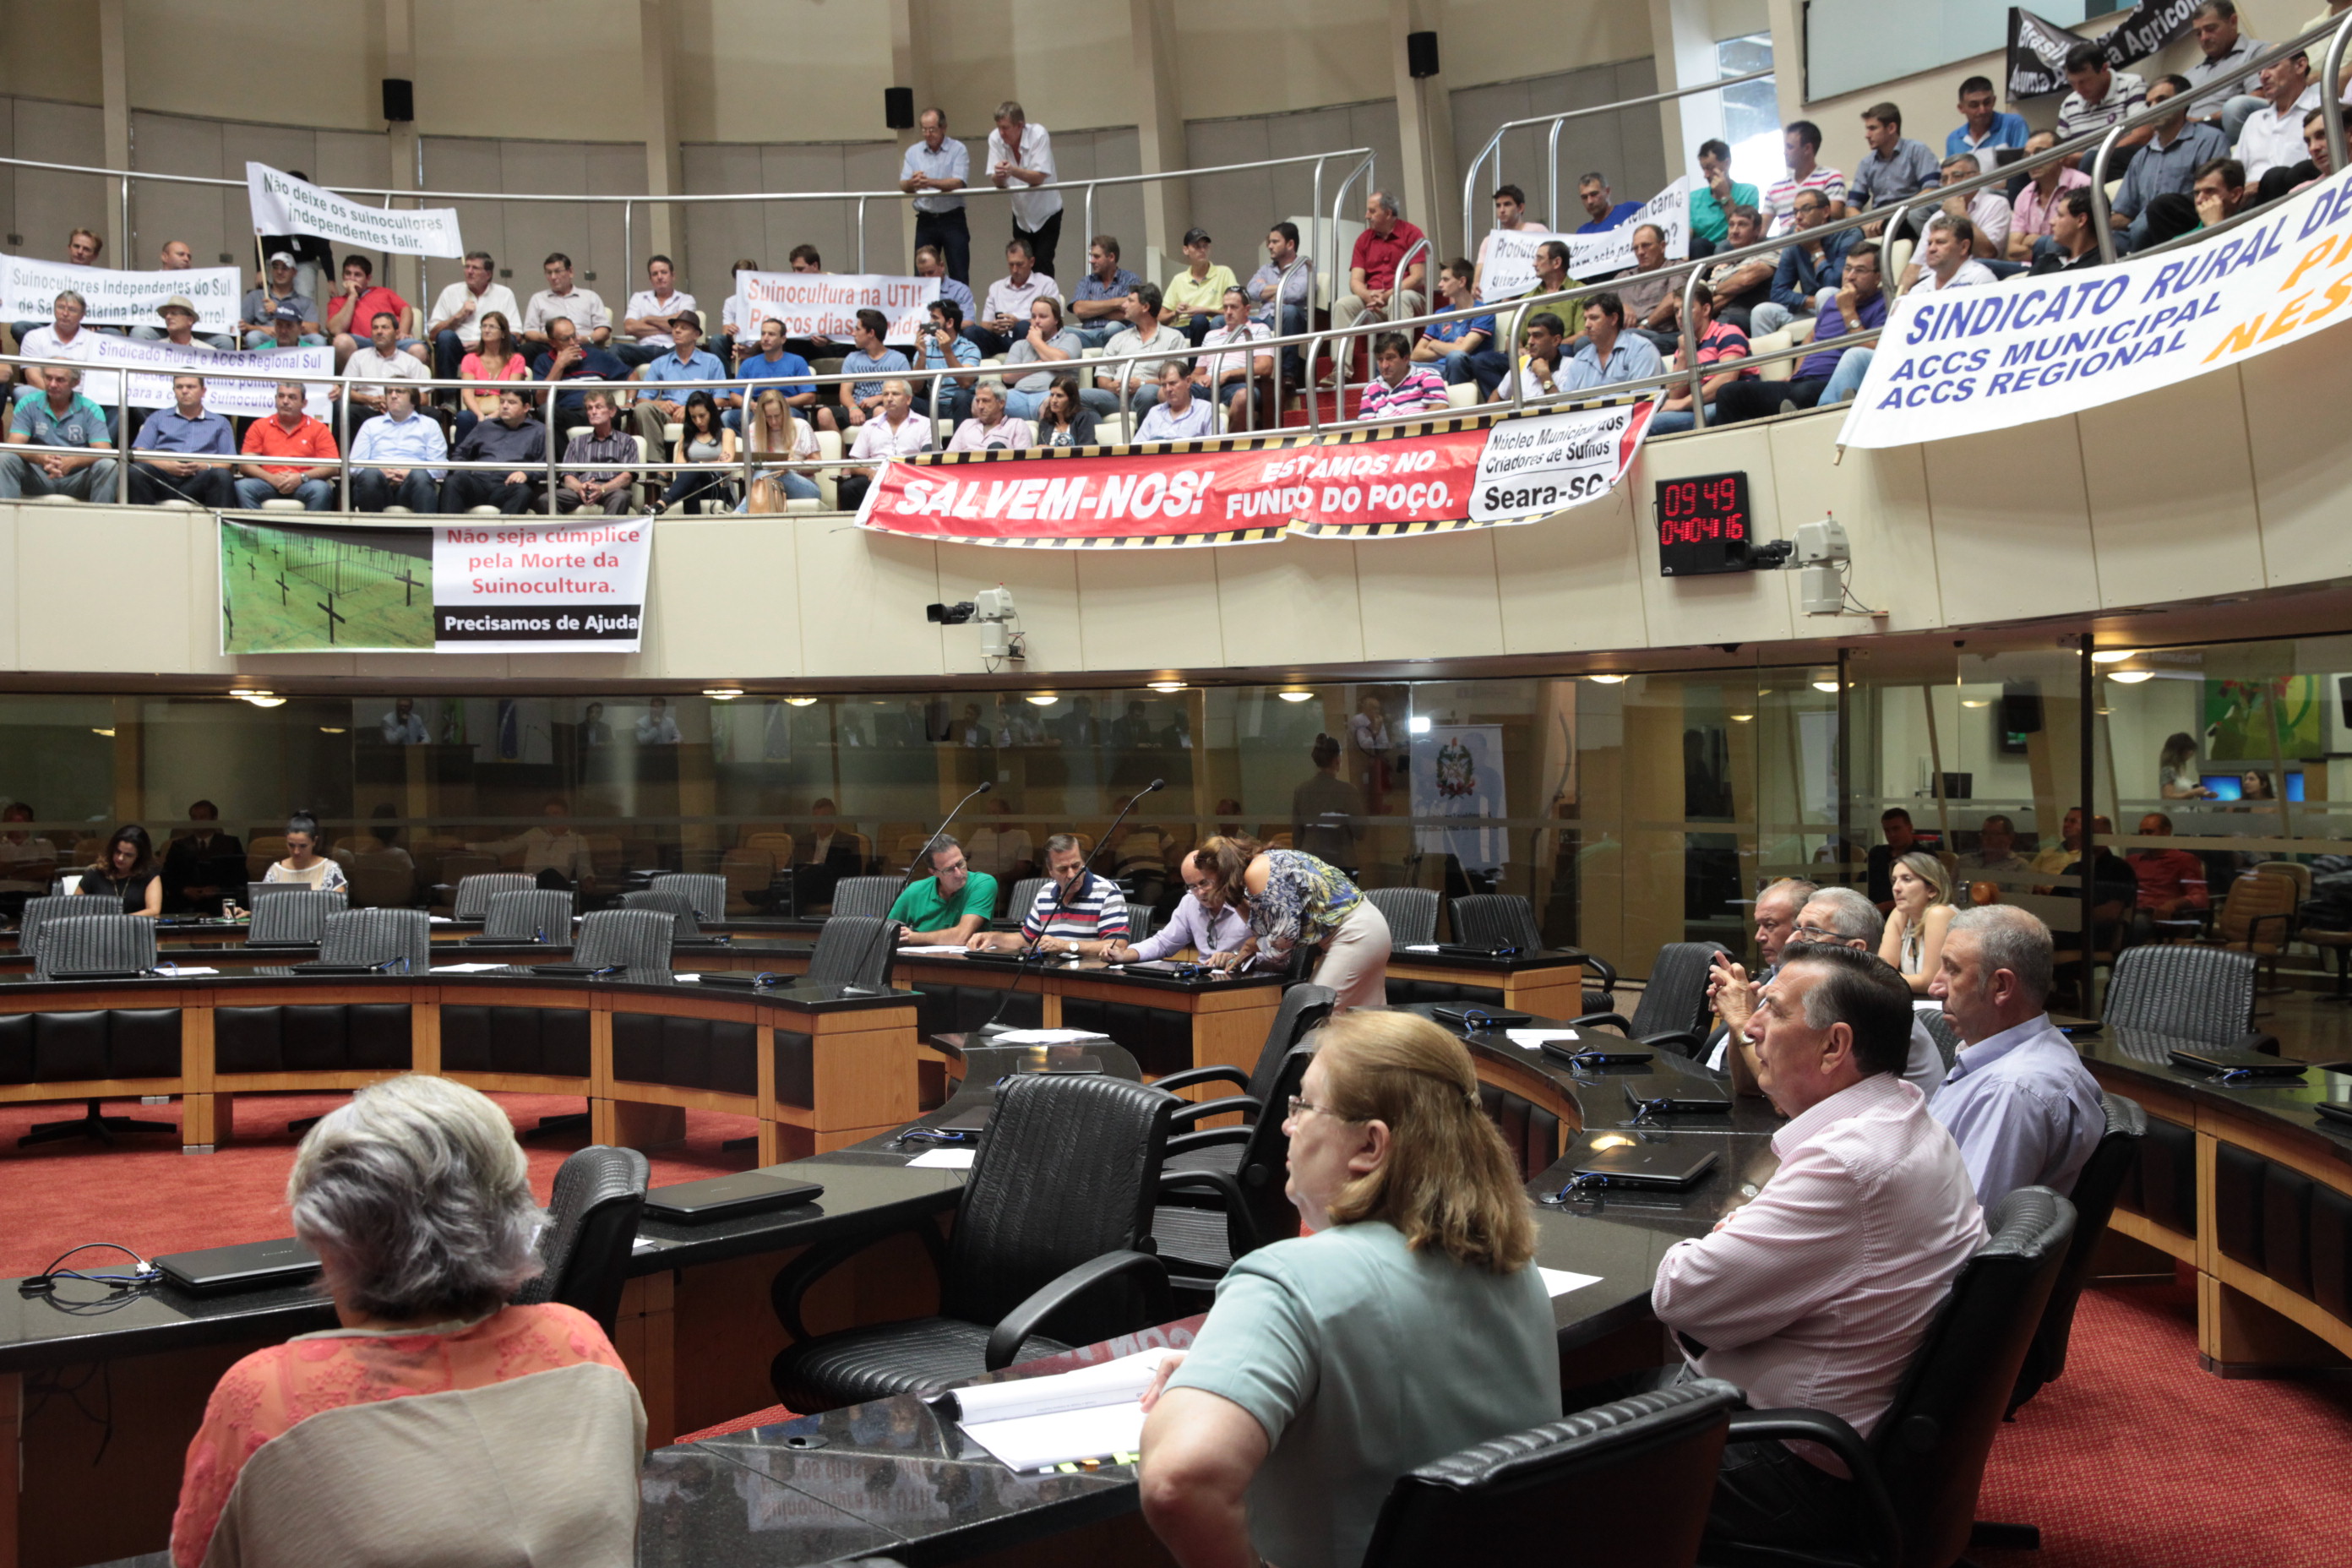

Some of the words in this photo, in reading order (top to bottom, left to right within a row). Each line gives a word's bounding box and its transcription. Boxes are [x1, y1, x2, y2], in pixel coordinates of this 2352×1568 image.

[263, 172, 289, 195] Não
[293, 185, 328, 210] deixe
[331, 206, 346, 219] os
[351, 210, 443, 231] suinocultores
[1651, 191, 1682, 216] carne
[288, 203, 389, 245] independentes
[391, 234, 423, 249] falir.
[13, 268, 100, 293] Suinocultores
[103, 279, 191, 297] Independentes
[194, 278, 209, 295] do
[213, 278, 231, 296] Sul
[748, 279, 854, 305] Suinocultura
[860, 289, 881, 306] na
[887, 282, 923, 308] UTI!
[1906, 275, 2130, 346] SINDICATO
[2139, 215, 2289, 305] RURAL
[19, 297, 33, 313] de
[817, 312, 853, 335] dias
[1888, 349, 1990, 381] ACCS
[1999, 291, 2221, 368] MUNICIPAL
[99, 341, 161, 362] Sindicado
[165, 347, 197, 366] Rural
[200, 353, 208, 366] e
[211, 351, 244, 367] ACCS
[248, 353, 300, 372] Regional
[303, 354, 321, 369] Sul
[1876, 378, 1976, 410] ACCS
[1985, 329, 2187, 397] REGIONAL
[1485, 453, 1544, 474] Criadores
[1546, 447, 1562, 463] de
[1566, 438, 1610, 460] Suínos
[1489, 432, 1534, 451] Núcleo
[1260, 455, 1390, 483] ESTAMOS
[1392, 450, 1437, 474] NO
[895, 470, 1215, 520] SALVEM-NOS!
[1226, 485, 1314, 520] FUNDO
[1320, 486, 1363, 513] DO
[1368, 481, 1454, 517] POÇO.
[1484, 473, 1604, 512] Seara-SC
[447, 529, 489, 544] Não
[497, 528, 537, 547] seja
[545, 526, 640, 546] cúmplice
[469, 553, 513, 572] pela
[521, 553, 585, 568] Morte
[593, 552, 618, 568] da
[472, 578, 616, 594] Suinocultura.
[444, 615, 551, 631] Precisamos
[556, 614, 580, 630] de
